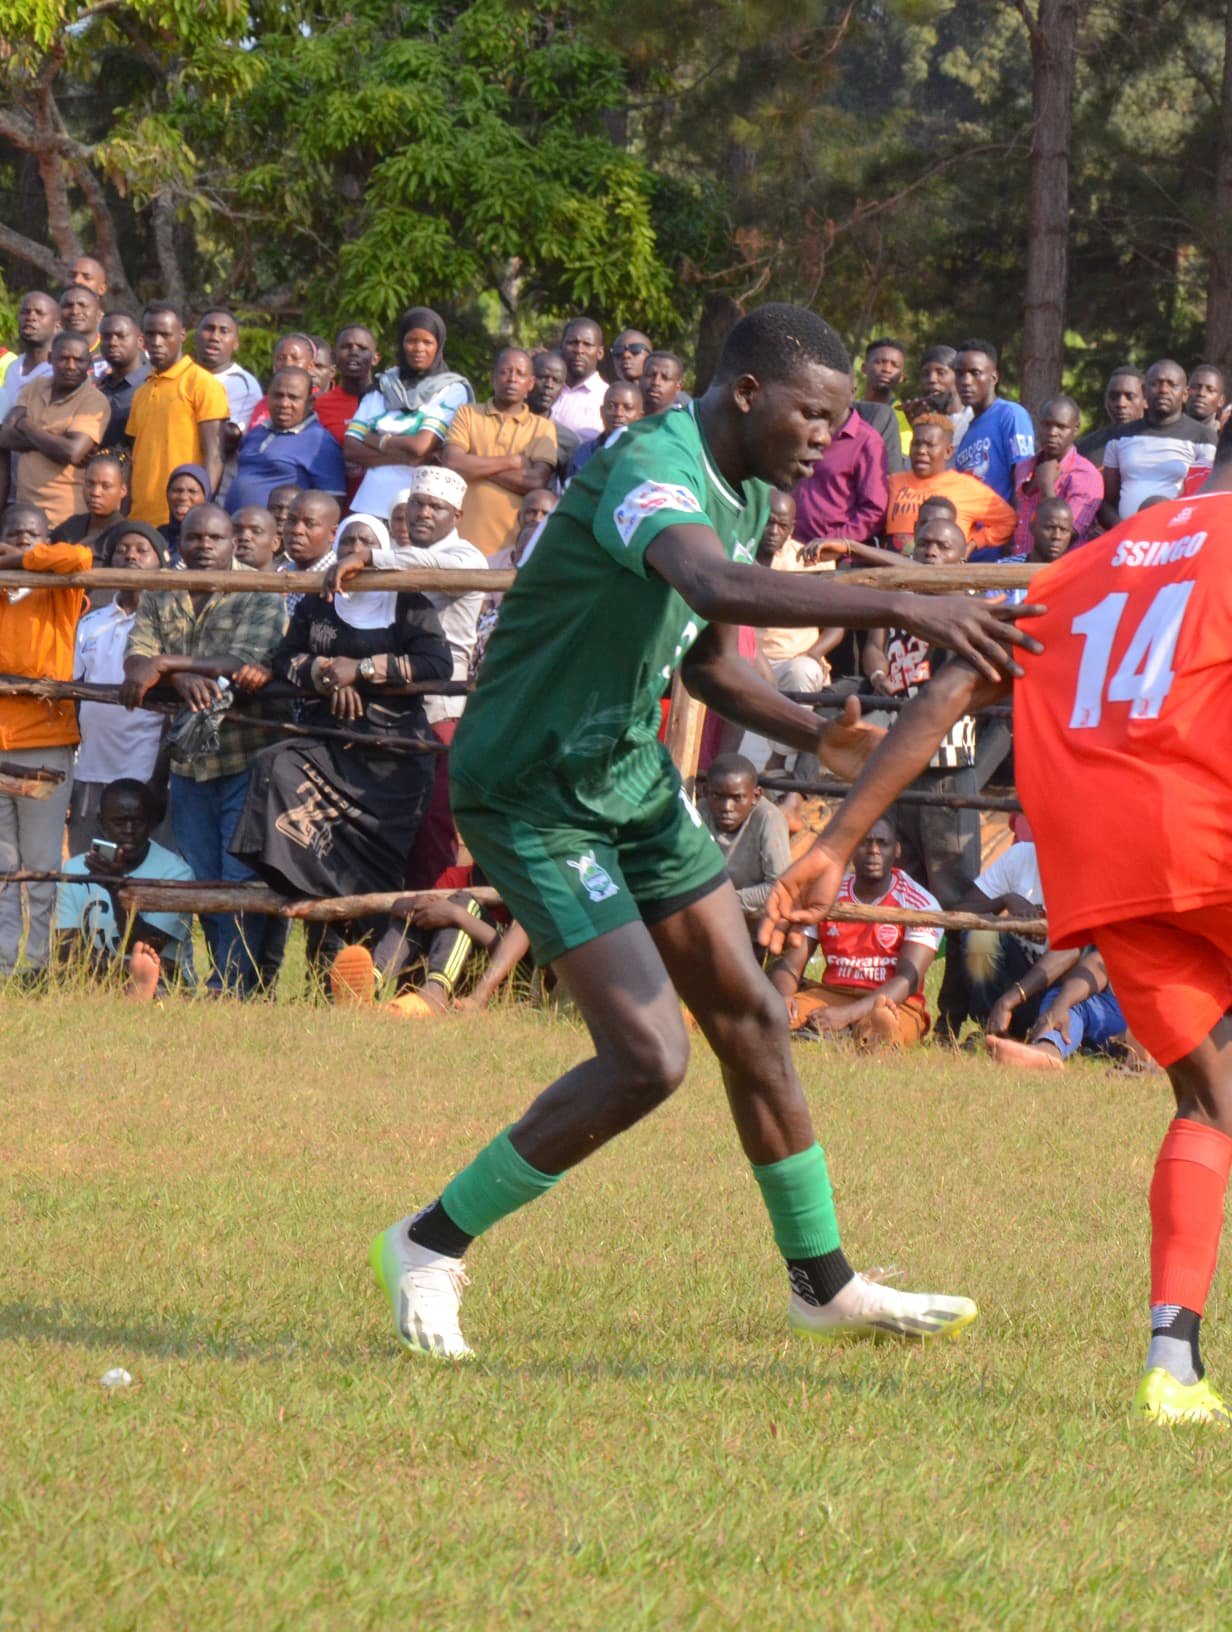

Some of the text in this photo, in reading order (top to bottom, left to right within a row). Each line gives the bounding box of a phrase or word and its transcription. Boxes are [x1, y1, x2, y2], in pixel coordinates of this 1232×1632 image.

[1111, 531, 1208, 567] SSINGO
[1069, 580, 1196, 728] 14
[827, 955, 898, 967] Emirates
